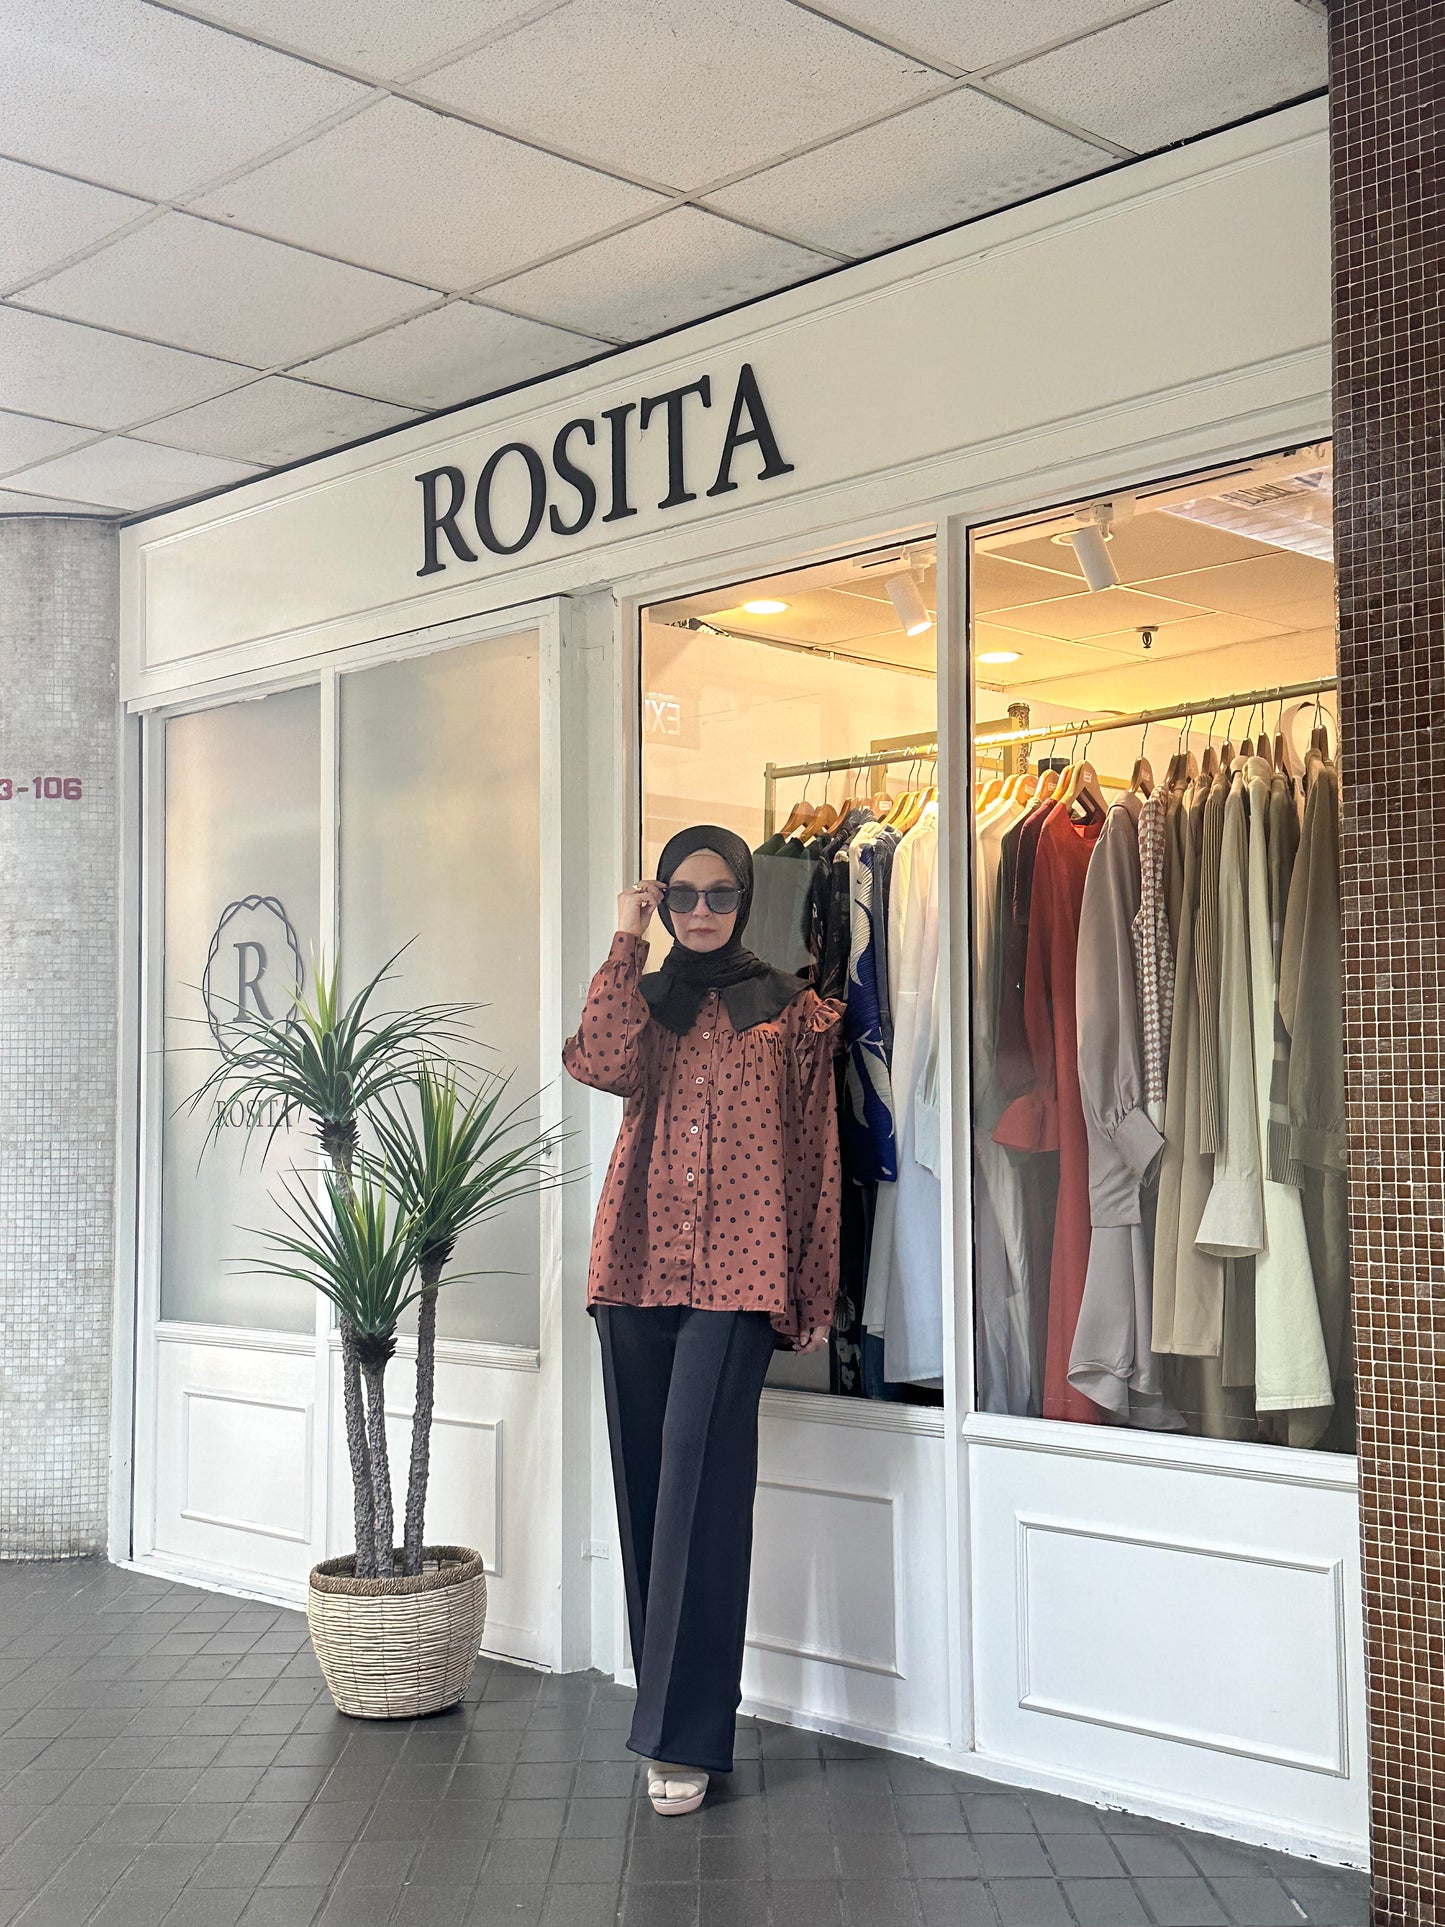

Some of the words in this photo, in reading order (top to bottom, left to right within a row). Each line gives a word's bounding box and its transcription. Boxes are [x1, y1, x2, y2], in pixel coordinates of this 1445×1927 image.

[414, 363, 795, 577] ROSITA
[233, 941, 273, 1021] R
[215, 1099, 293, 1128] ROSITA
